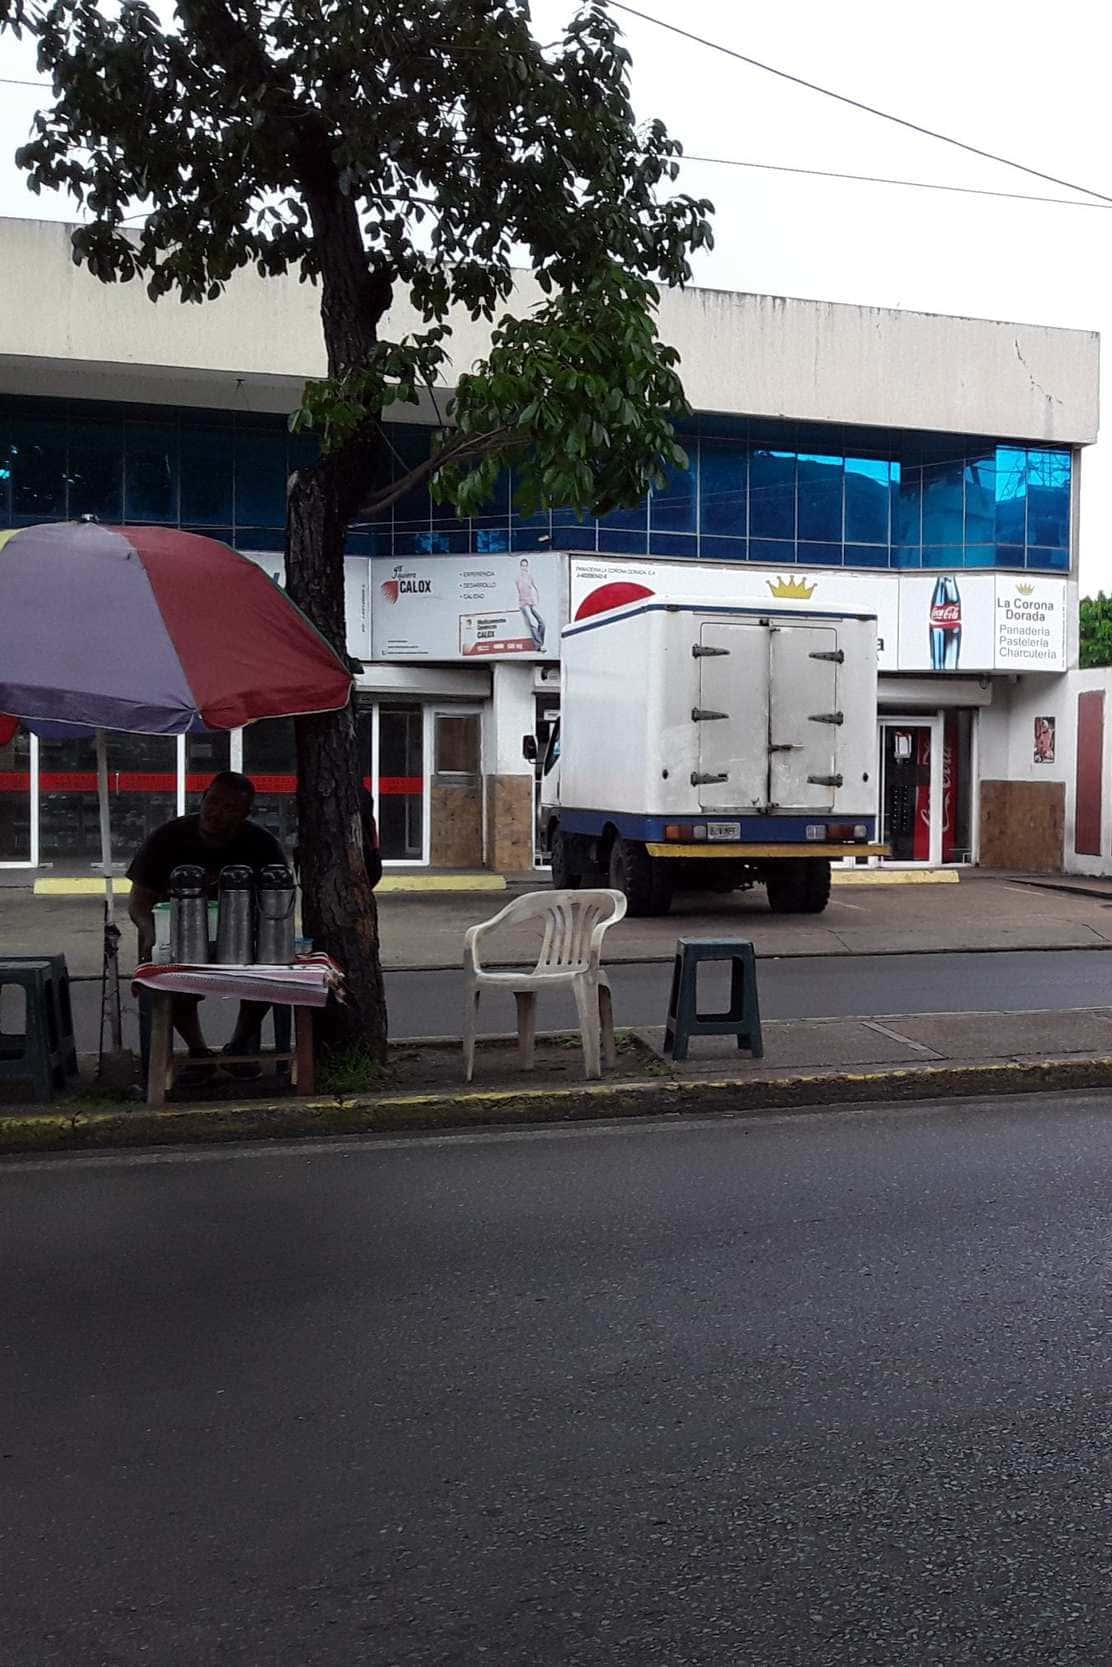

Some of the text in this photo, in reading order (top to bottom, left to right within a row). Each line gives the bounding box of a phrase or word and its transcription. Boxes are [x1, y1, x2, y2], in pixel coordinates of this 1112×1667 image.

[400, 580, 431, 593] CALOX
[997, 597, 1054, 611] La Corona
[1006, 609, 1045, 622] Dorada
